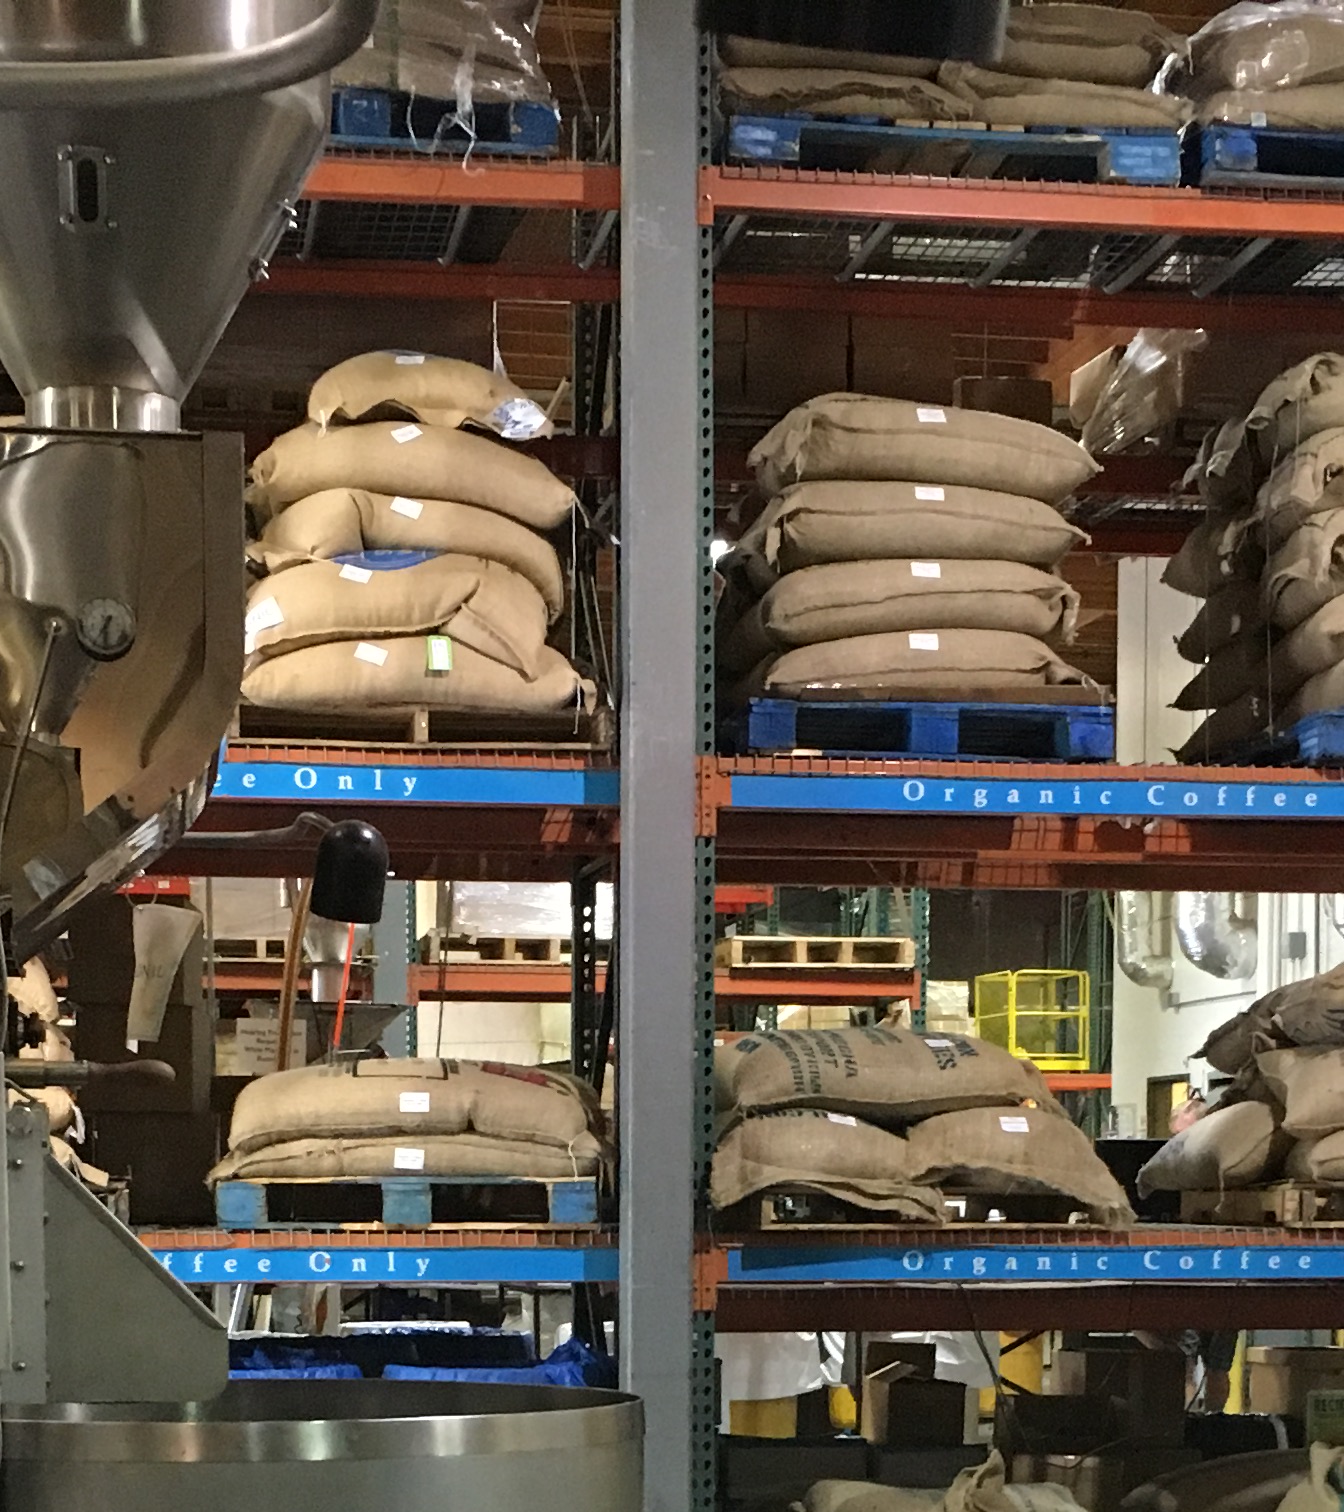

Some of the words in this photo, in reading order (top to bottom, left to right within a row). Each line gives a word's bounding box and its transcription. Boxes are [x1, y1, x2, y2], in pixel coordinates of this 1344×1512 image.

[293, 766, 418, 797] Only
[902, 779, 1113, 808] Organic
[1146, 784, 1318, 808] Coffee
[308, 1250, 430, 1276] Only
[902, 1250, 1109, 1276] Organic
[1142, 1249, 1311, 1271] Coffee
